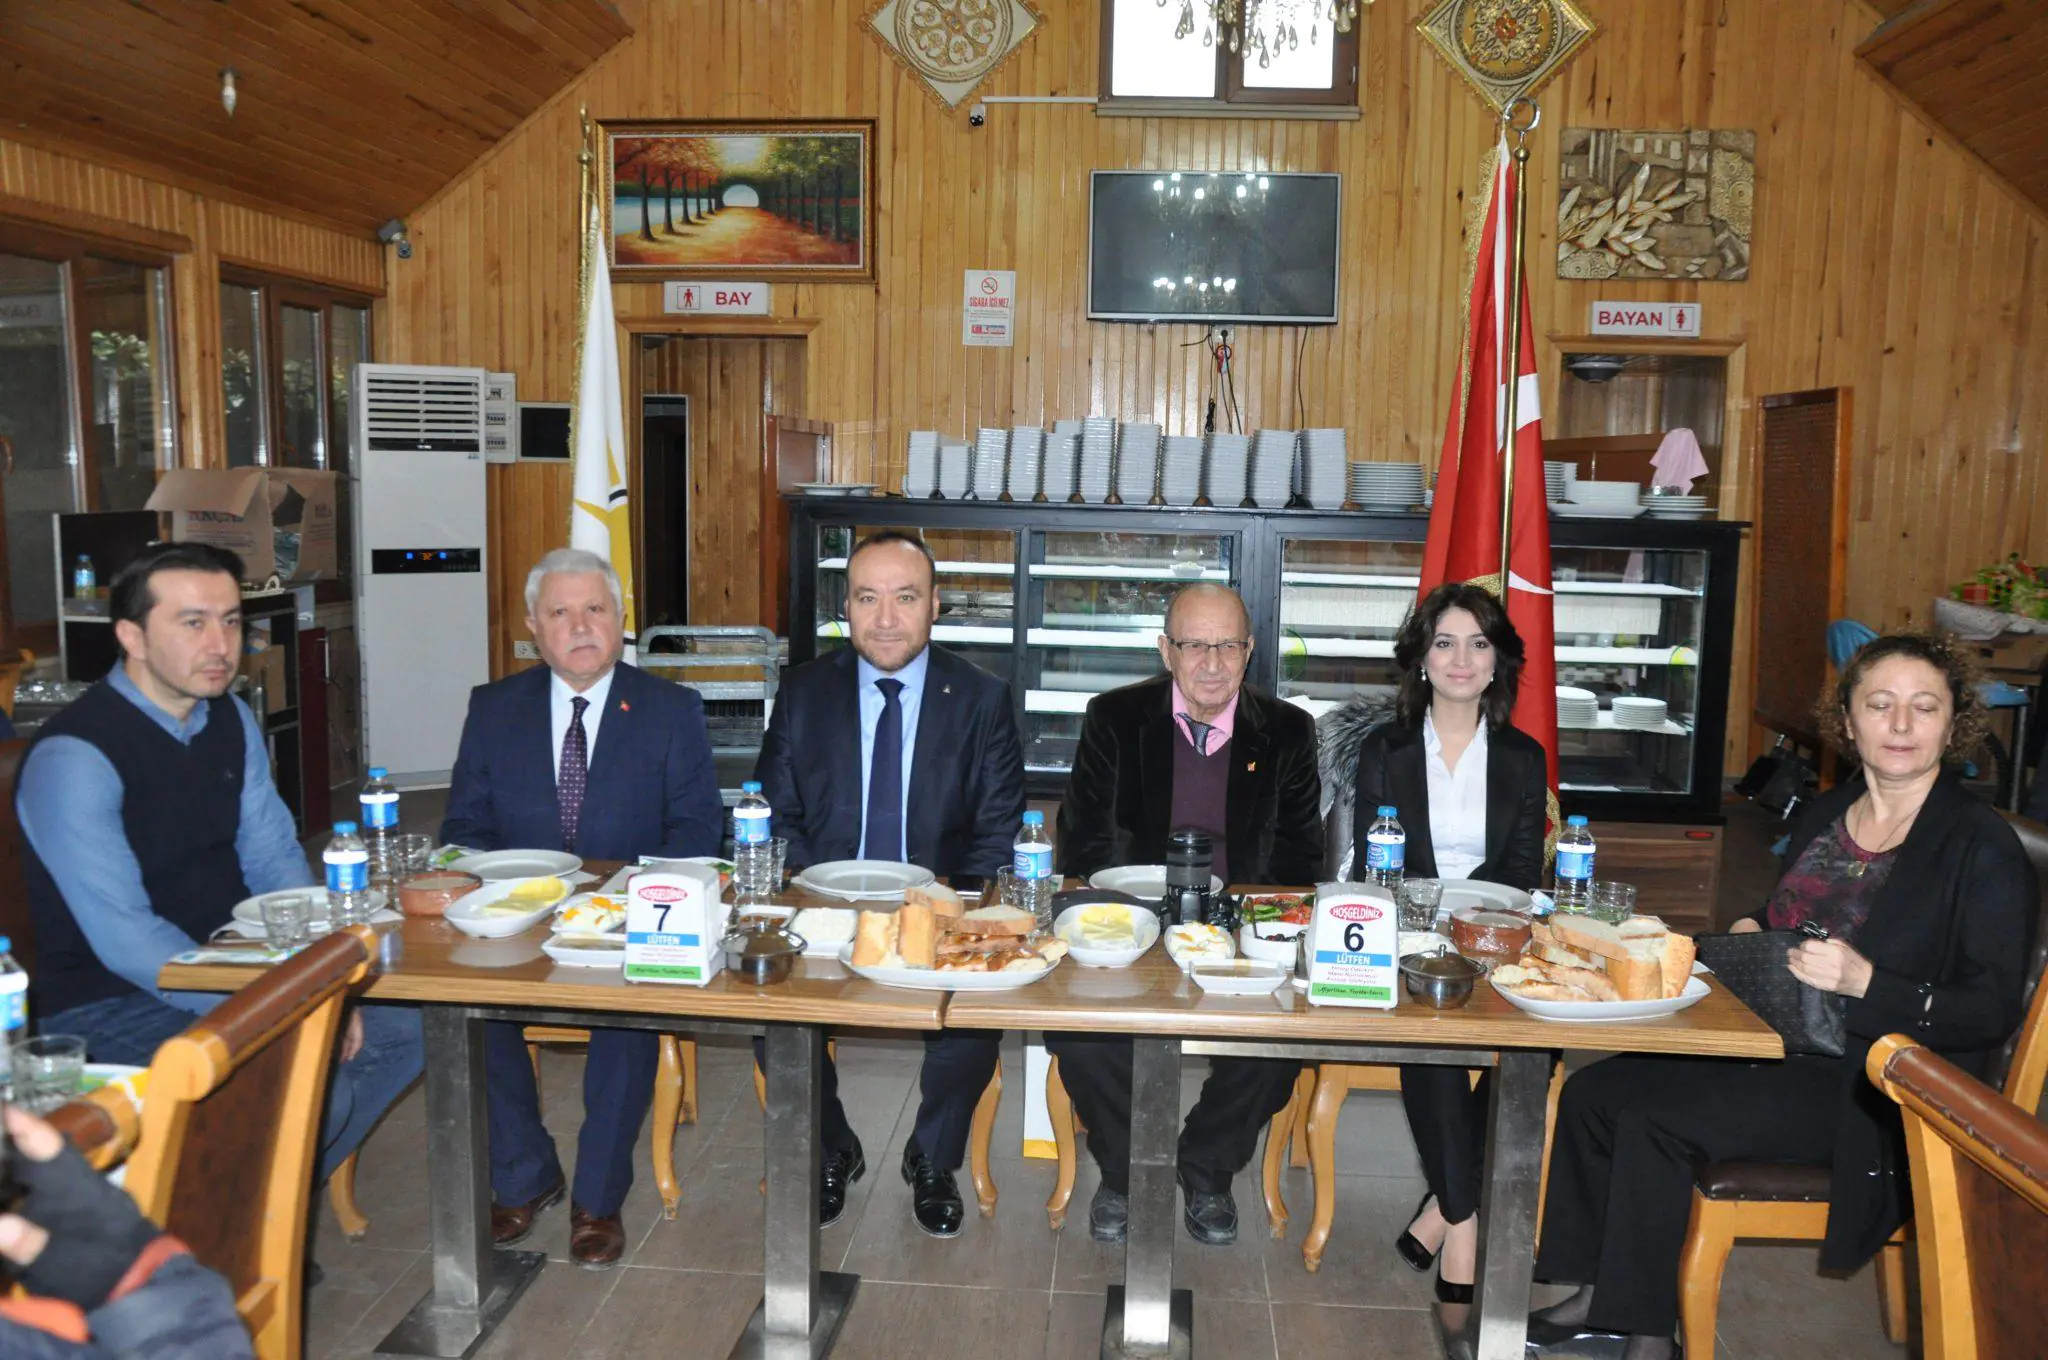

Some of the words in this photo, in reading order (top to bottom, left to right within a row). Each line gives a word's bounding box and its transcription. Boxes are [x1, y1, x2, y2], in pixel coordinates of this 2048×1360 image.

[715, 291, 752, 306] BAY
[1598, 310, 1663, 326] BAYAN
[653, 904, 672, 932] 7
[1343, 922, 1365, 952] 6
[1336, 951, 1371, 965] LÜTFEN
